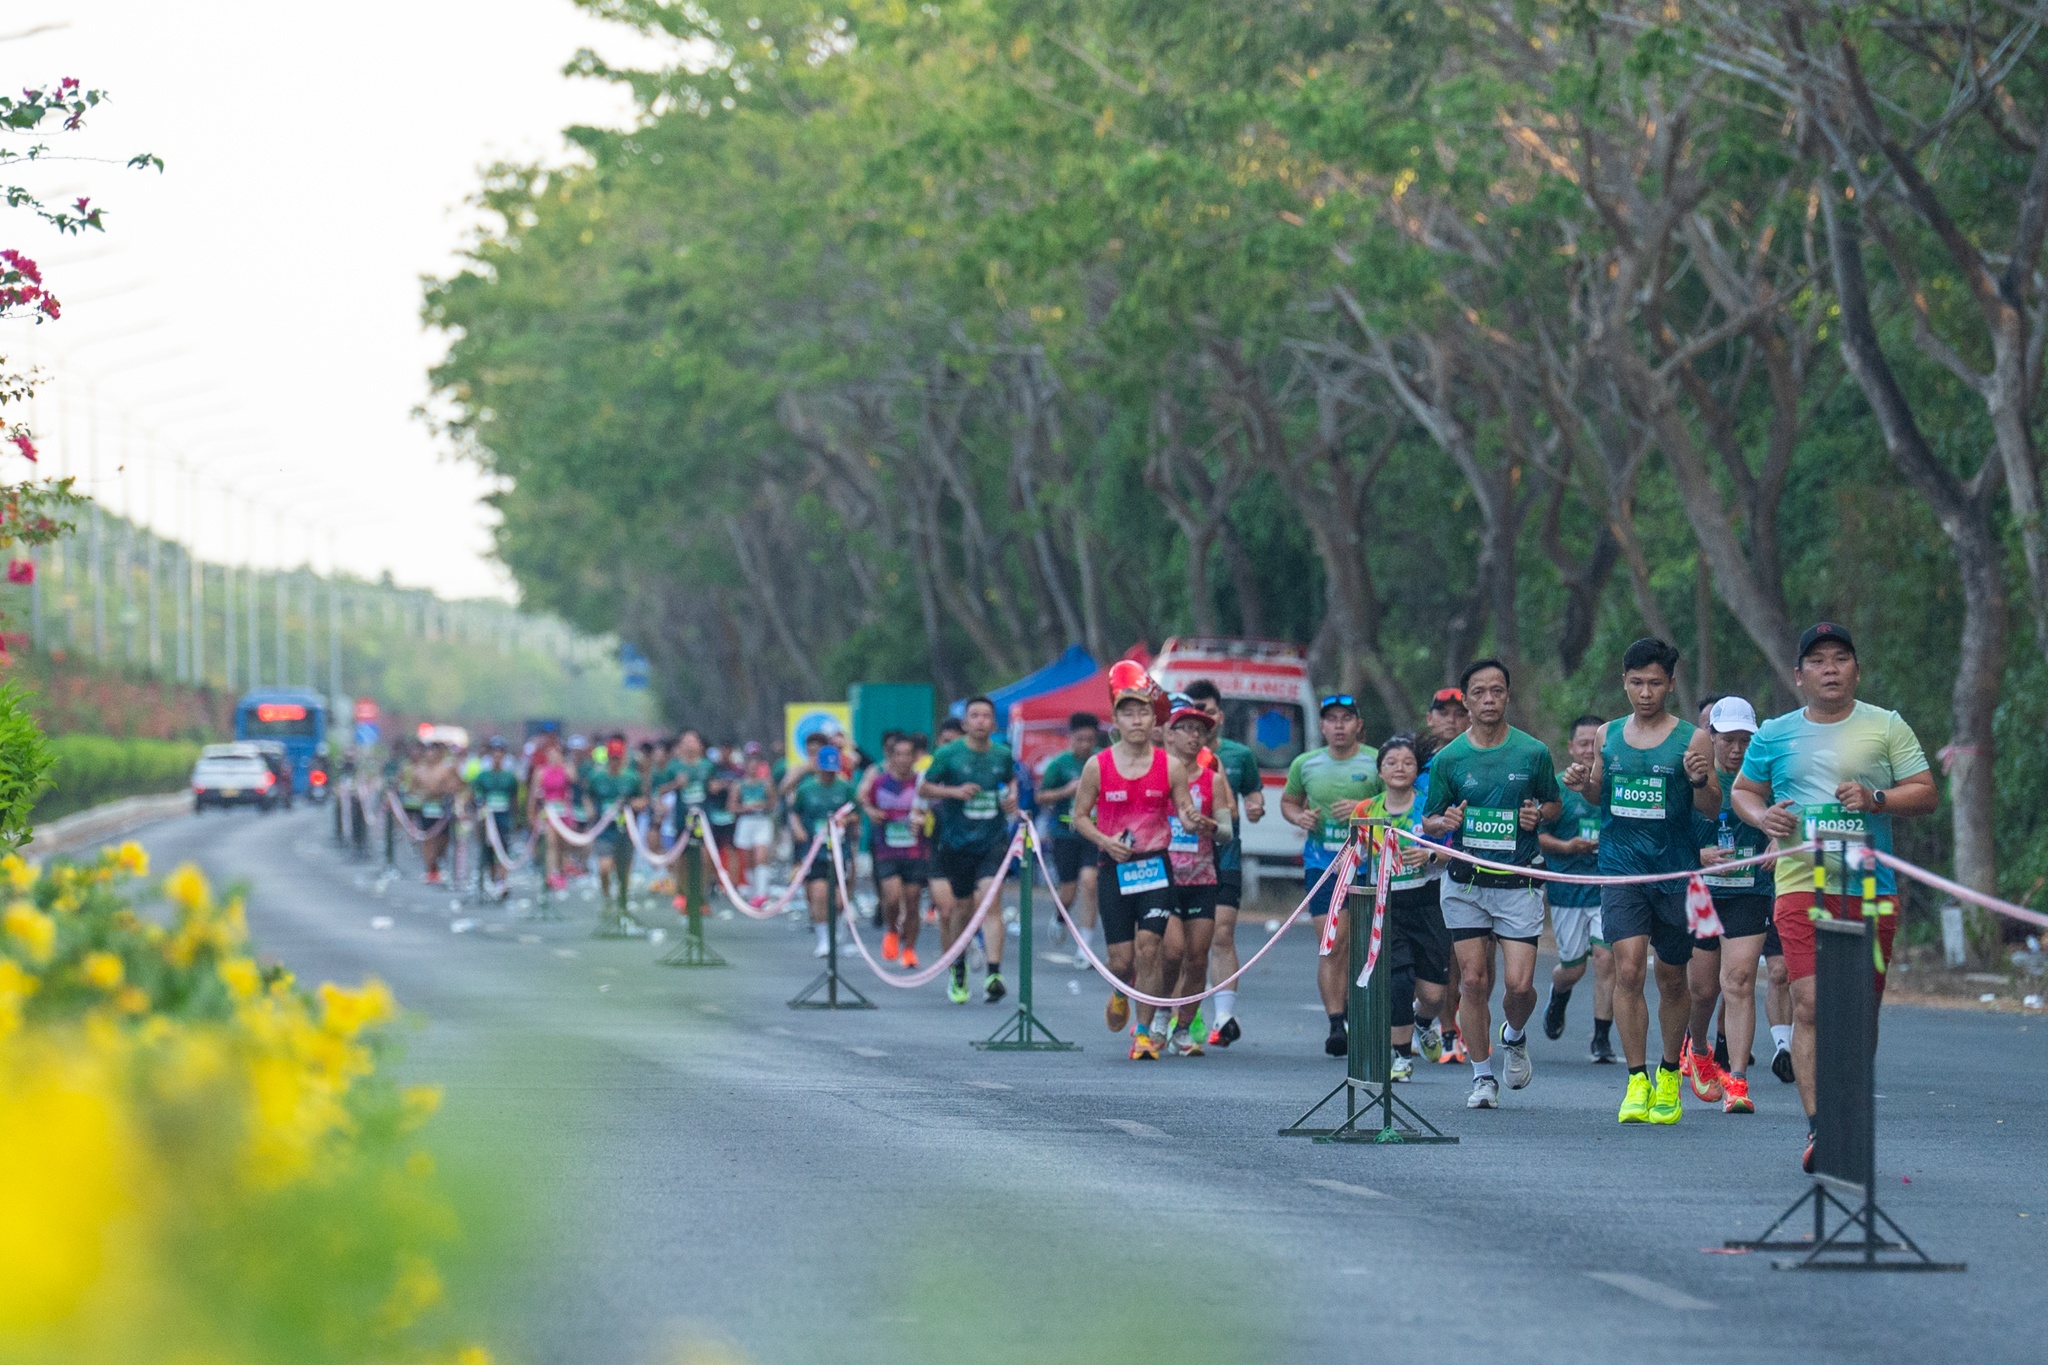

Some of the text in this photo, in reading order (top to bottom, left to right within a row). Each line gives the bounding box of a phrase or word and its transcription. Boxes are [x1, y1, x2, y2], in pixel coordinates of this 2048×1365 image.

[1624, 788, 1663, 802] 80935
[1466, 819, 1514, 834] M 80709
[1818, 818, 1864, 832] 80892
[1123, 867, 1159, 882] 88007
